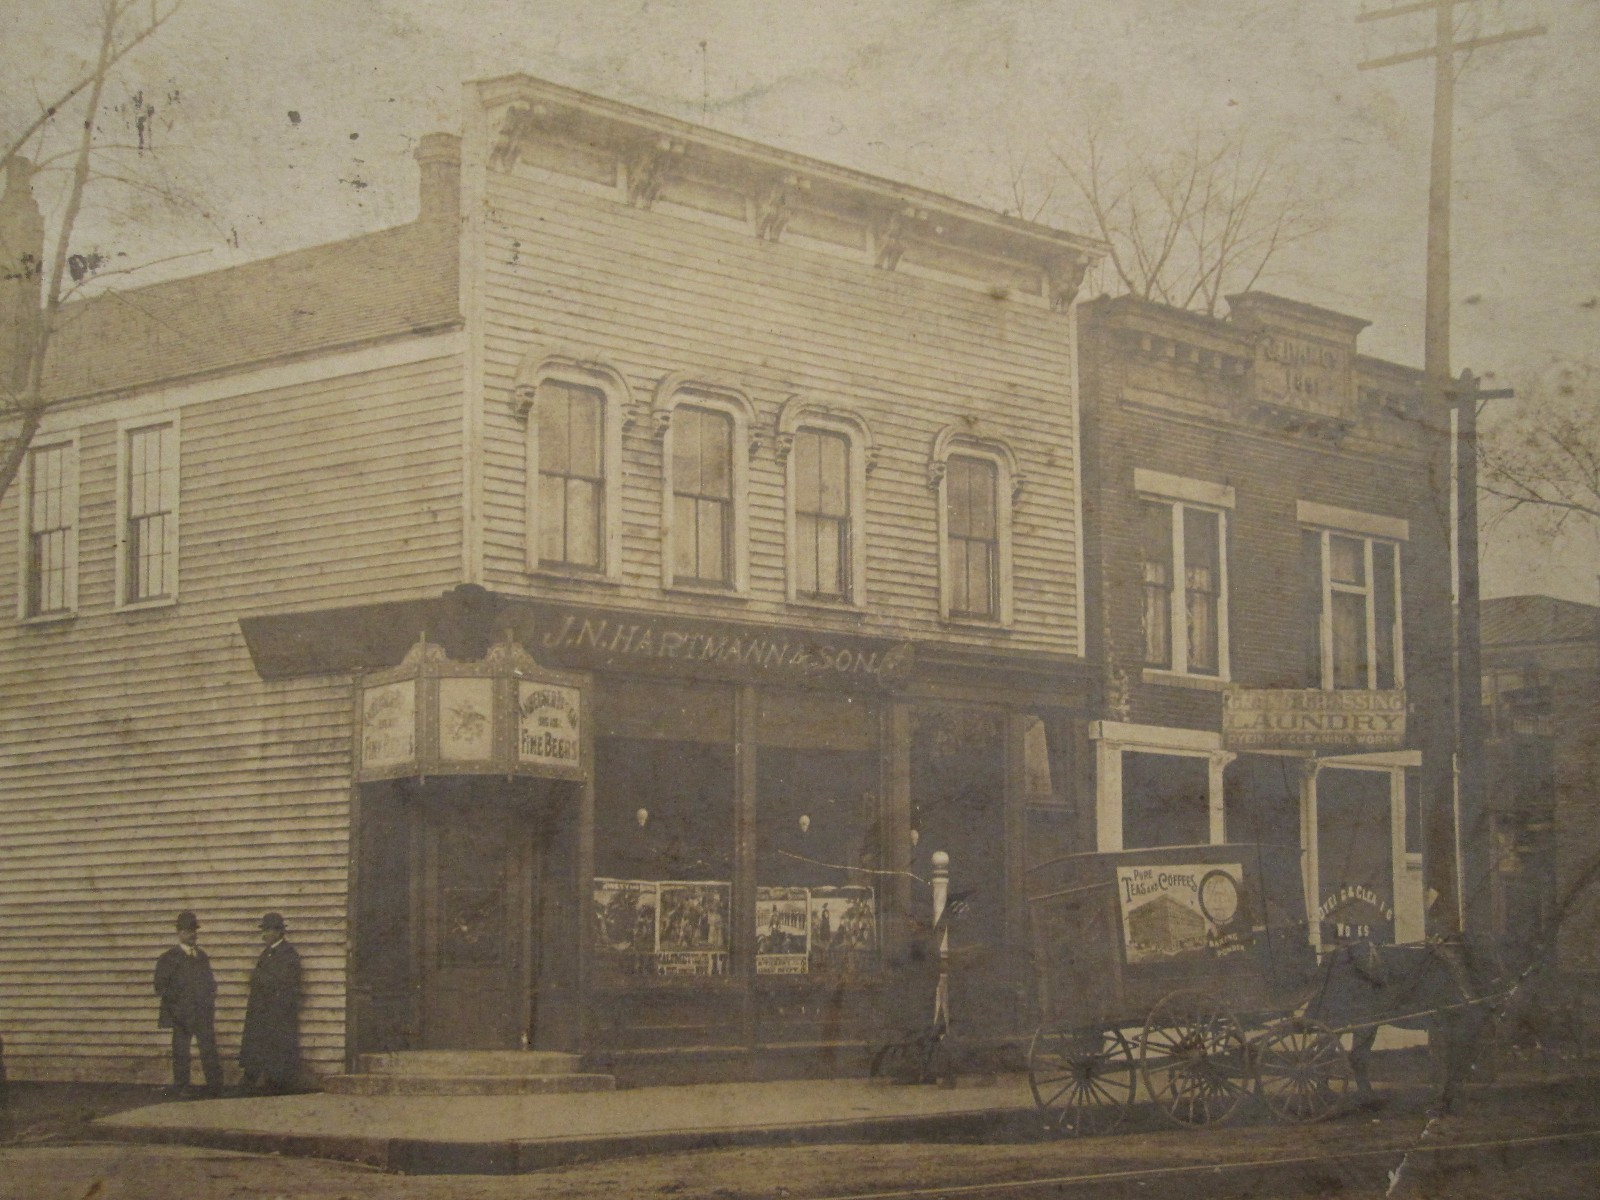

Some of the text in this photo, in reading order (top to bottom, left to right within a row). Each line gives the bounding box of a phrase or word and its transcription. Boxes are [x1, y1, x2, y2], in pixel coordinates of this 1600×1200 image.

[1227, 713, 1402, 731] LAUNDRY
[1121, 876, 1146, 902] TEAS
[1158, 872, 1198, 893] COFFEES
